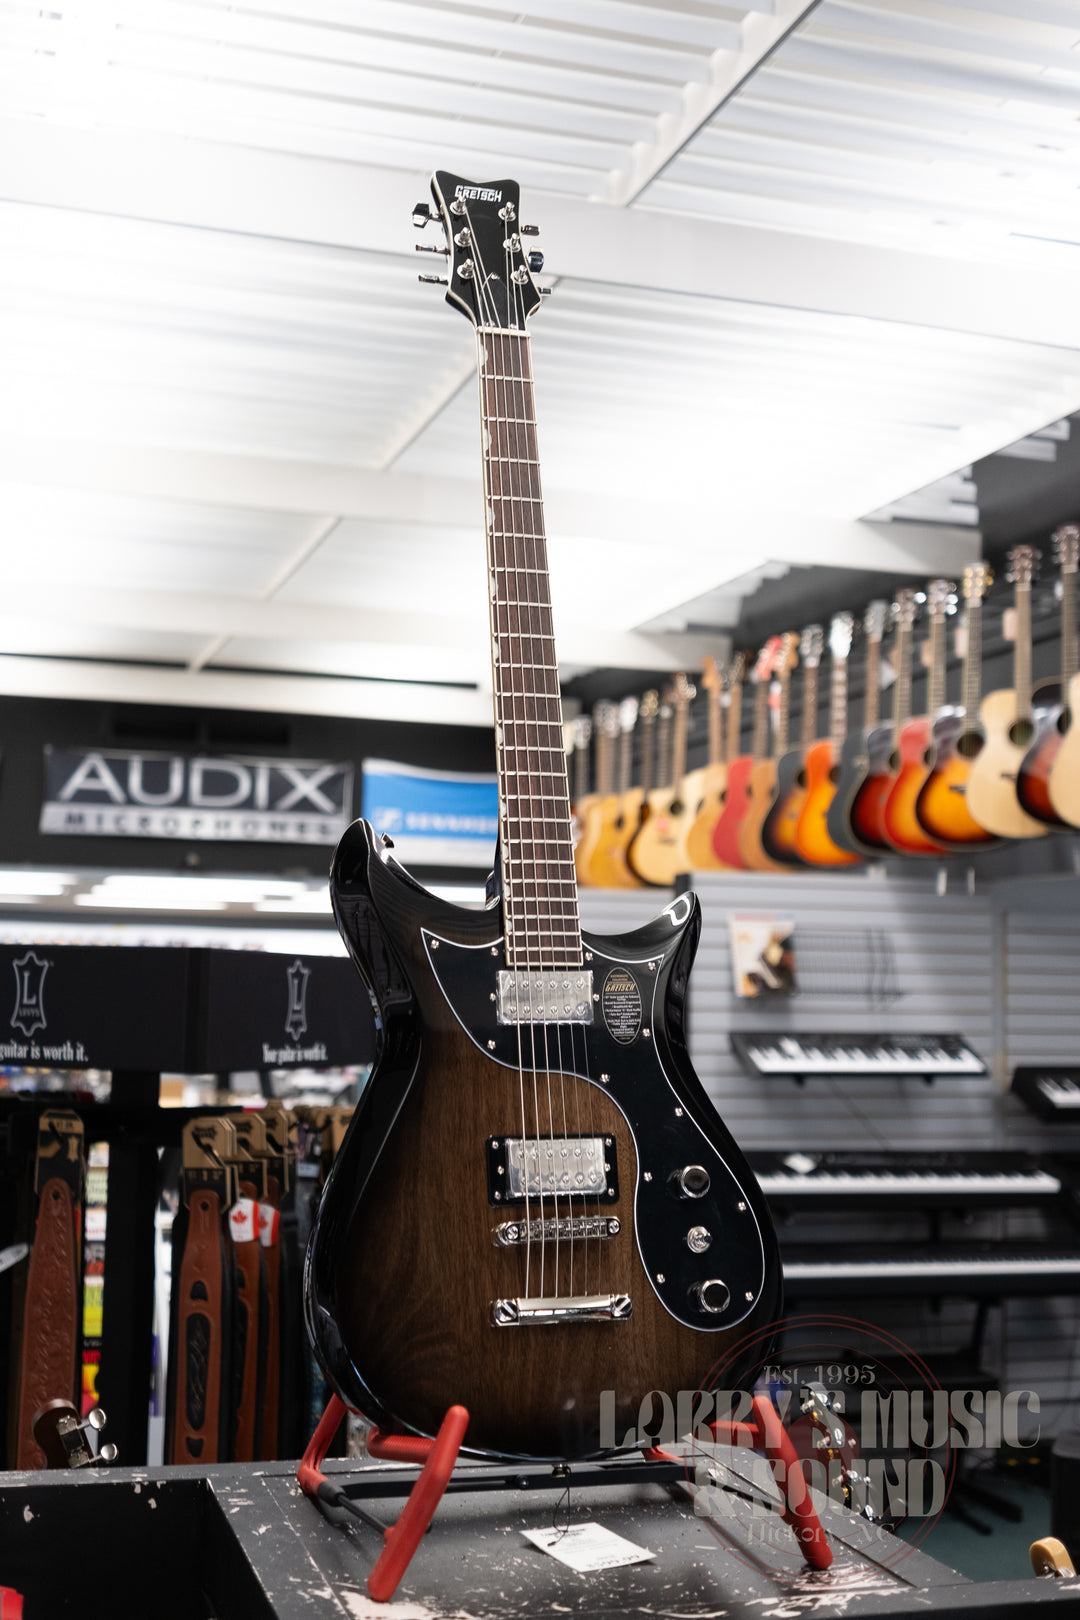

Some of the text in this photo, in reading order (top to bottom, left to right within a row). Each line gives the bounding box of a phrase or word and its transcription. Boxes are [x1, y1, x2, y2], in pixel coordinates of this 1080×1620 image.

[454, 185, 502, 202] GRETSCH
[59, 754, 339, 814] AUDIX
[30, 1040, 40, 1060] is
[42, 1040, 74, 1061] worth
[76, 1042, 88, 1062] it.
